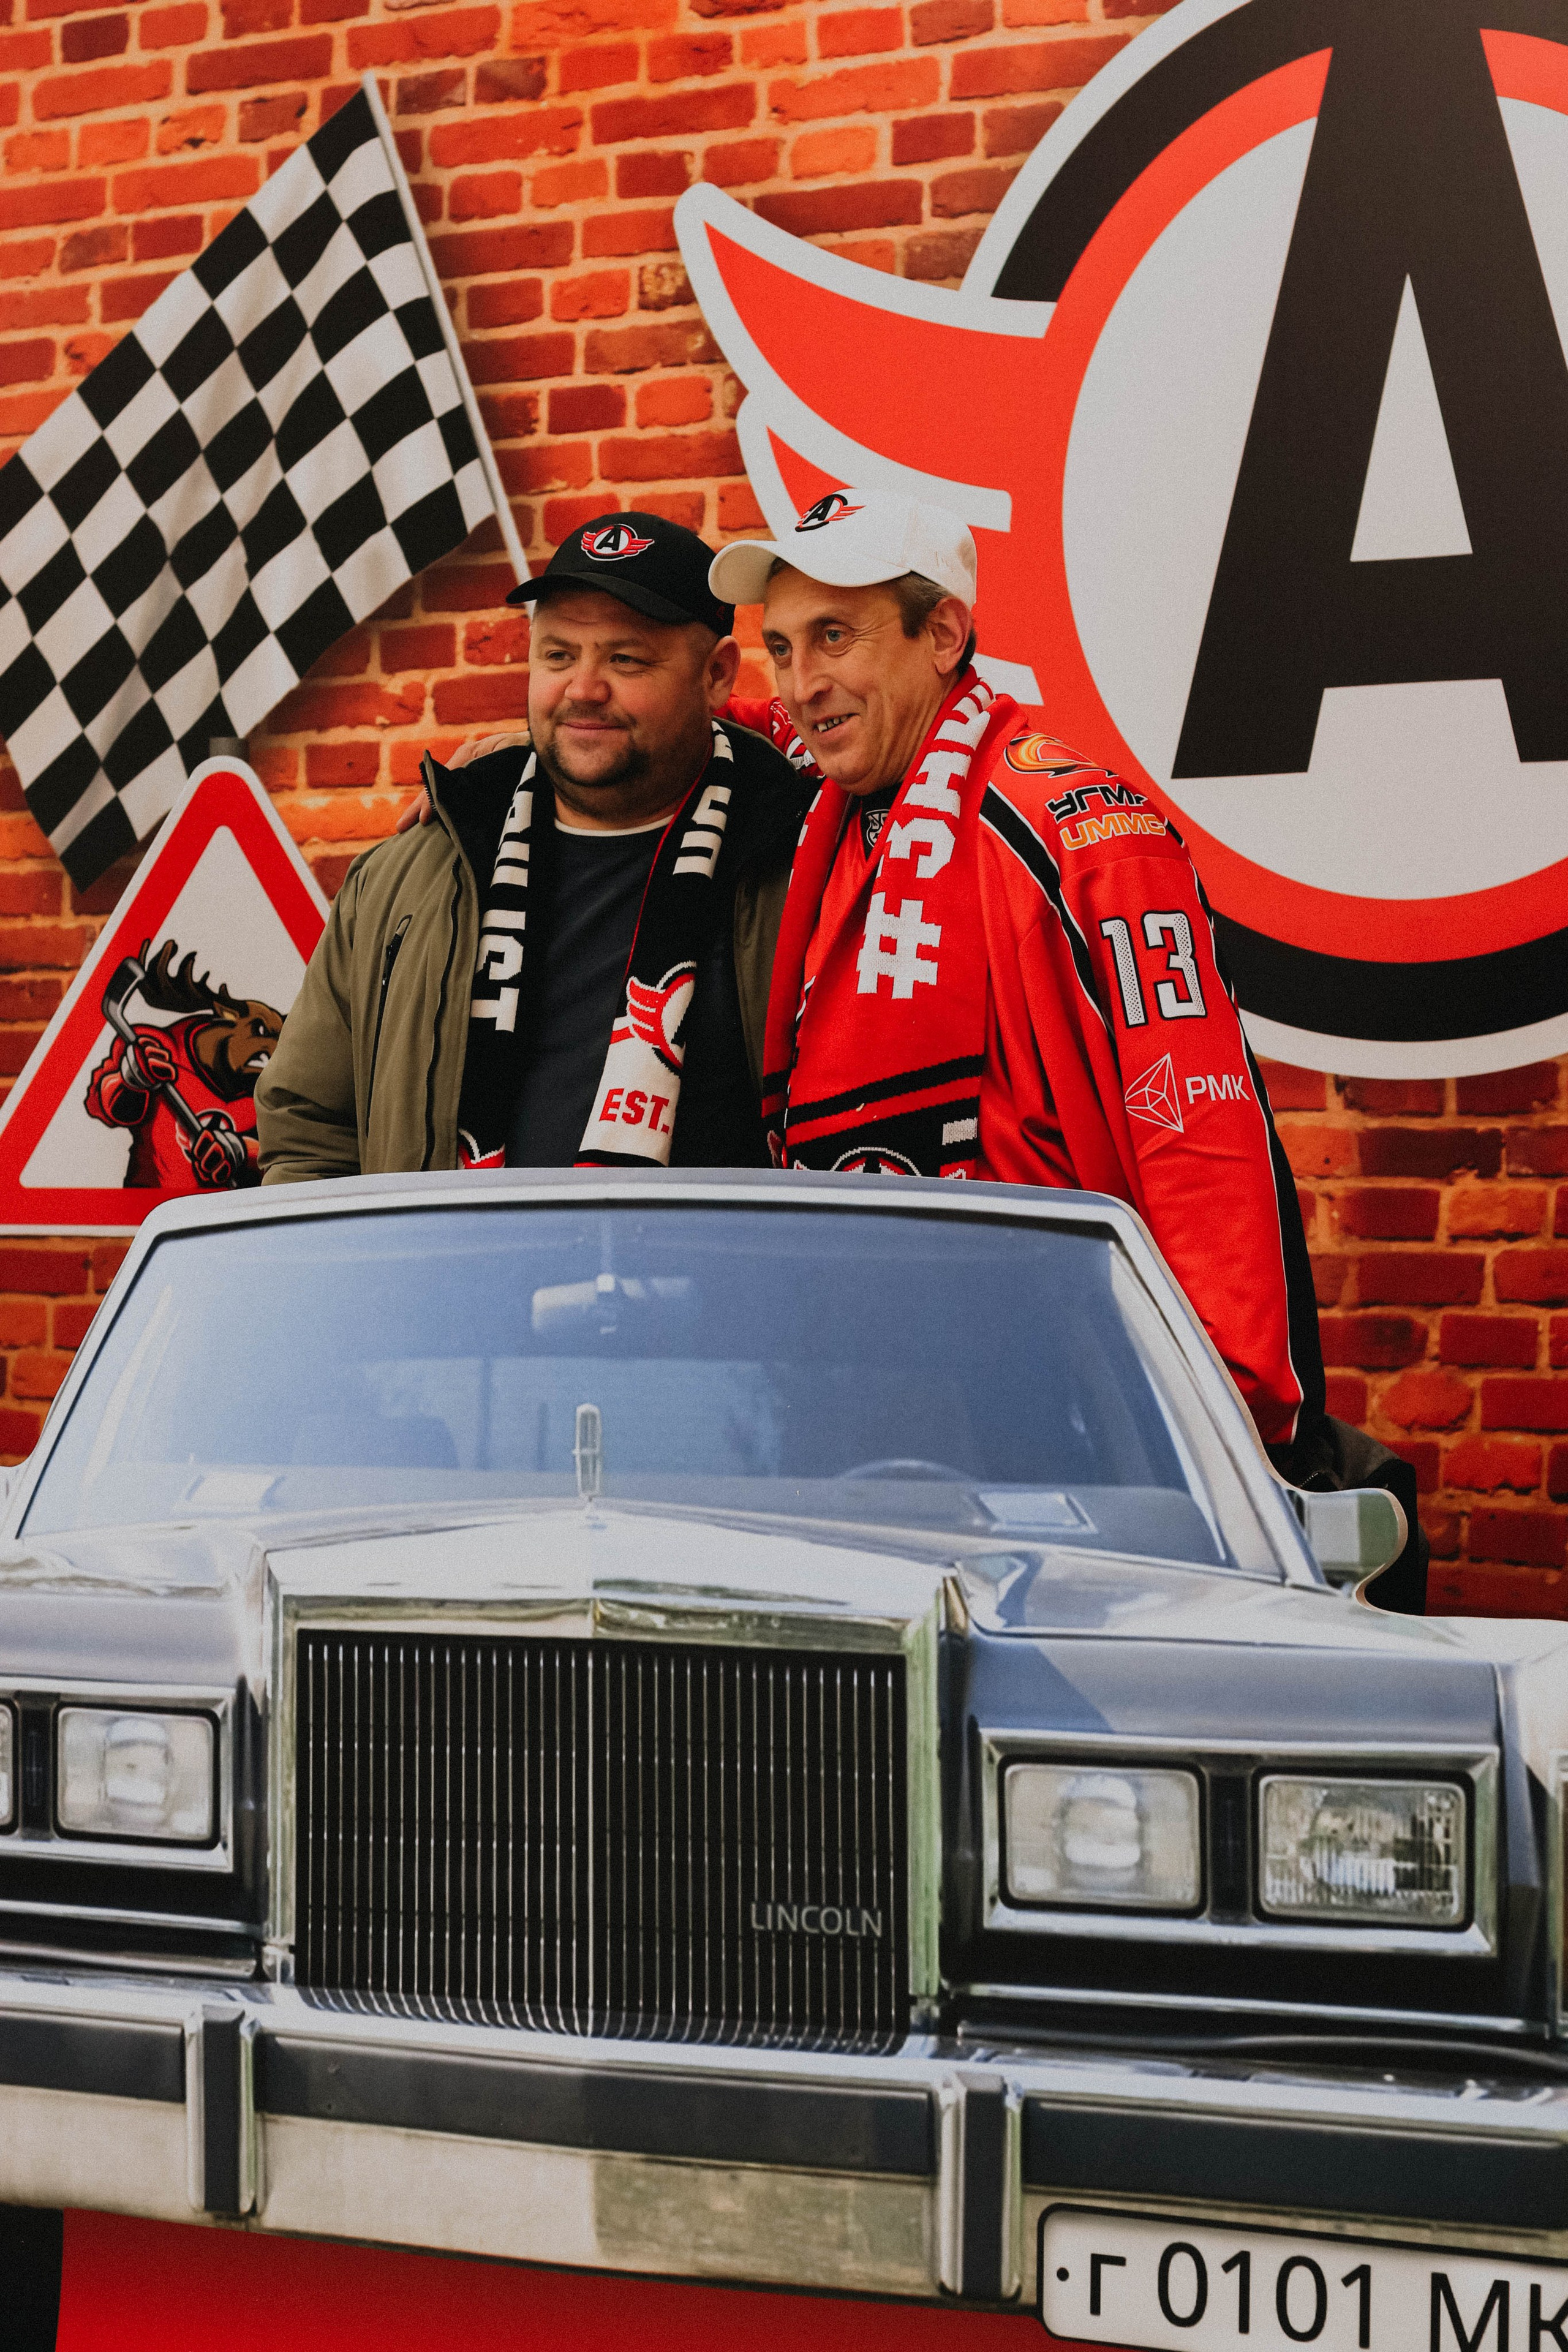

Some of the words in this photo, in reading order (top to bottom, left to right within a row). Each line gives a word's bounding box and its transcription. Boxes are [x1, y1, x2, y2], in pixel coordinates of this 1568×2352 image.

[1060, 813, 1166, 851] UMMC
[1099, 910, 1207, 1028] 13
[599, 1088, 669, 1134] EST.
[752, 1902, 882, 1937] LINCOLN
[1158, 2242, 1371, 2349] 0101
